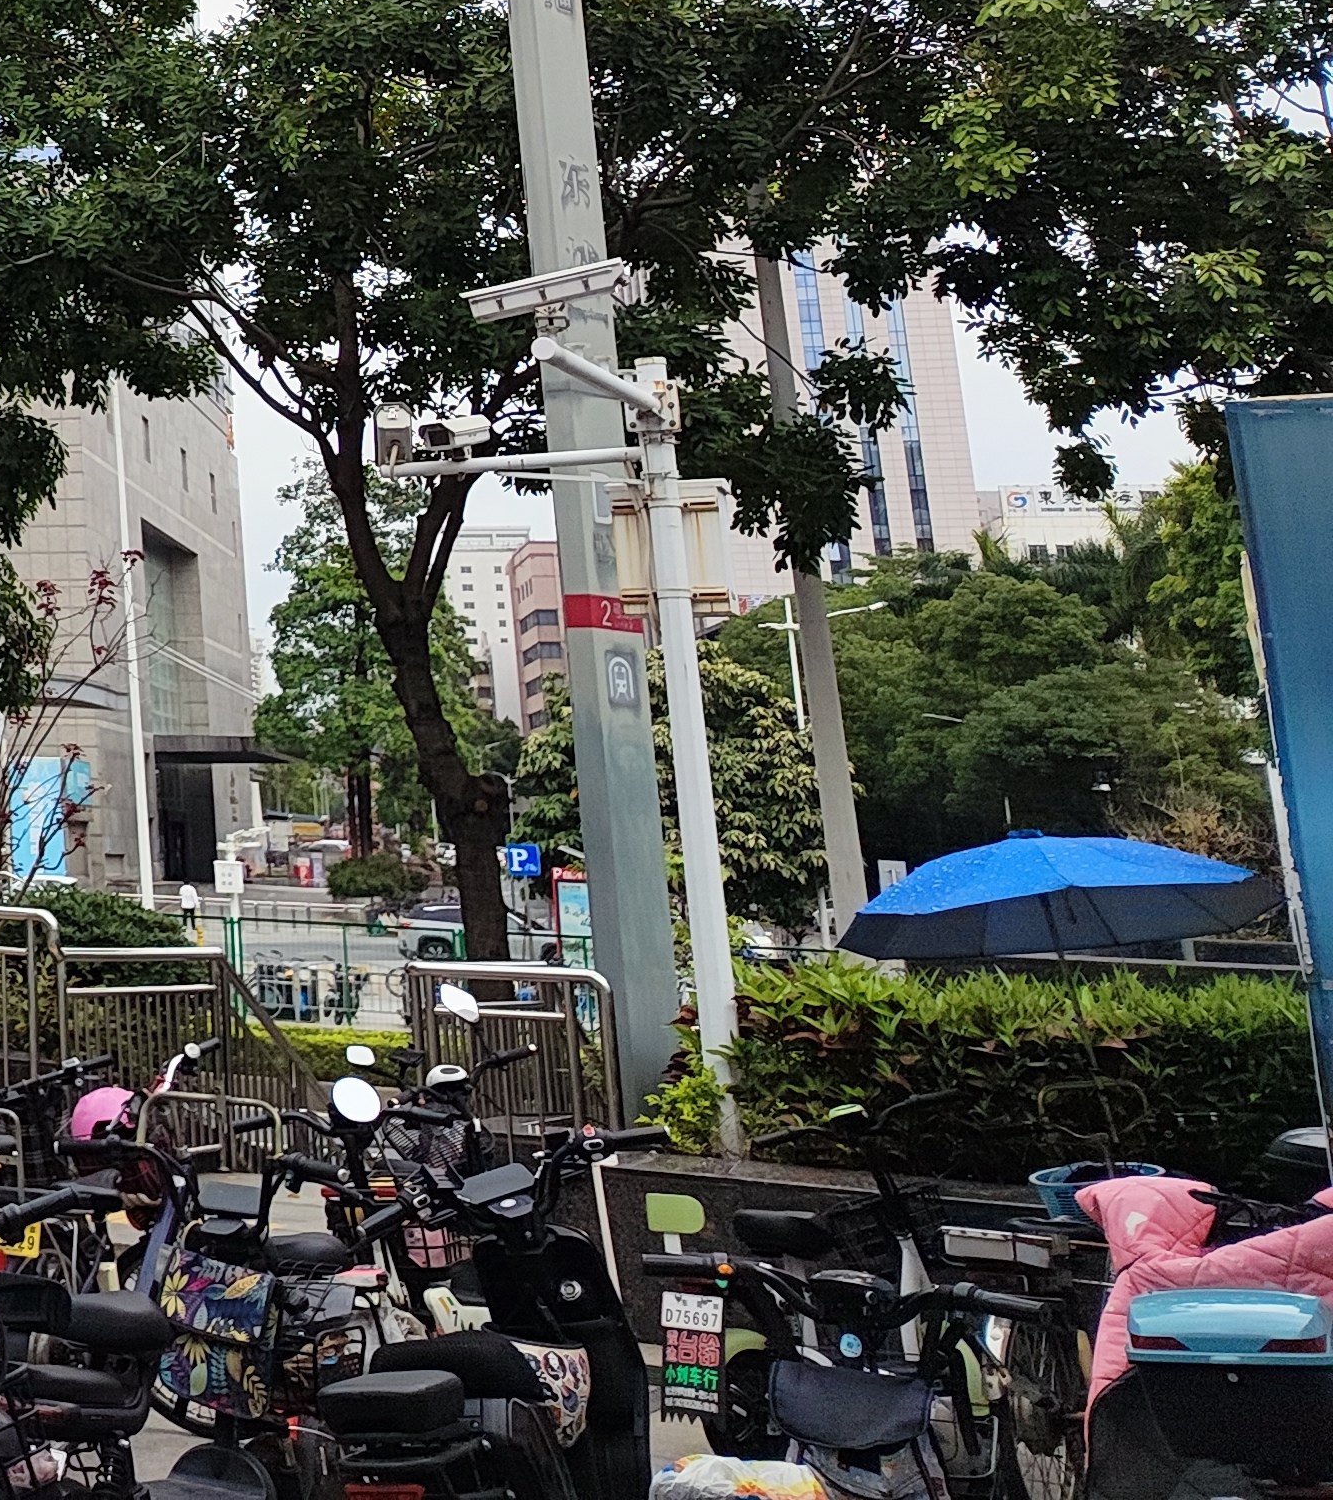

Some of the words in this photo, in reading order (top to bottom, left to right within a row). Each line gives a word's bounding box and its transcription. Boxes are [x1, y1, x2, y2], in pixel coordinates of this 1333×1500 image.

[510, 848, 529, 872] P
[665, 1308, 719, 1328] D75697
[678, 1331, 721, 1367] 台铃
[665, 1364, 720, 1391] 小刘车行
